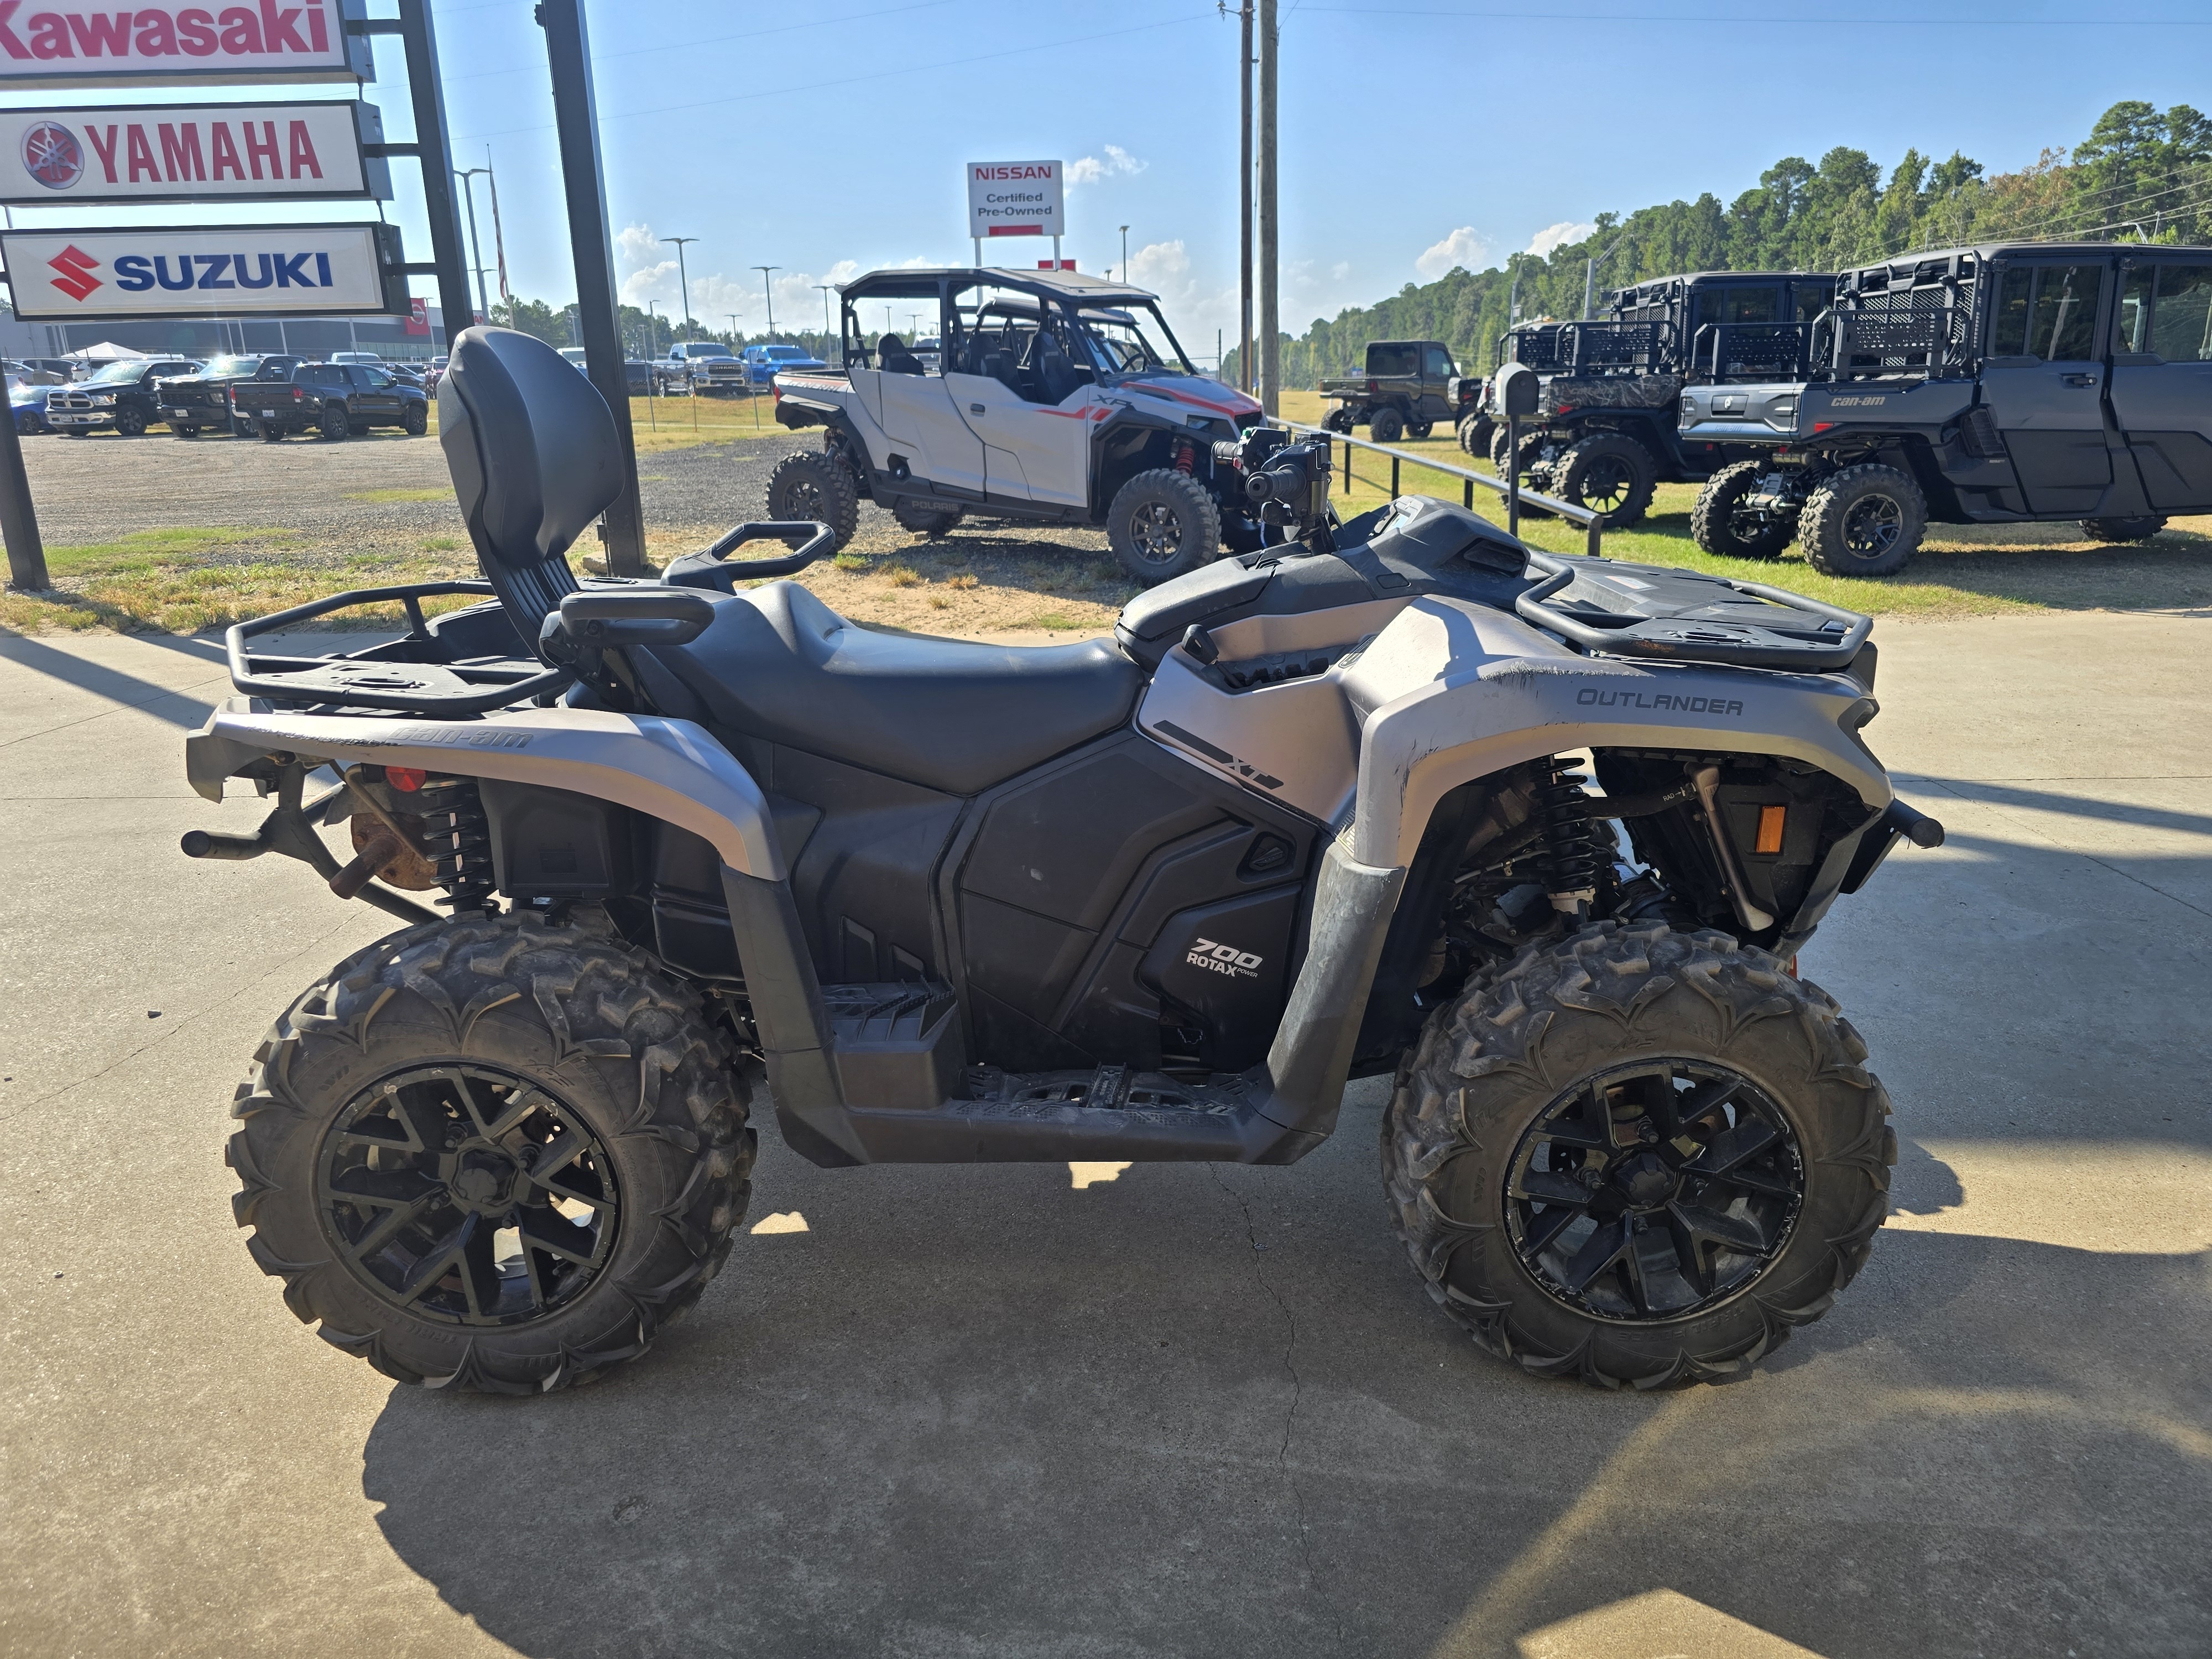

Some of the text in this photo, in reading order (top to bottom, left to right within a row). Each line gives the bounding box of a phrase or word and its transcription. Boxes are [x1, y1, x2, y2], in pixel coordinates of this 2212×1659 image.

[84, 120, 324, 183] YAMAHA
[975, 166, 1051, 180] NISSAN
[987, 193, 1043, 203] Certified
[978, 206, 1052, 216] Pre-Owned
[114, 253, 333, 291] SUZUKI
[787, 381, 840, 394] GENERAL
[1831, 397, 1886, 406] can-am
[912, 501, 959, 512] POLARIS
[1577, 688, 1744, 716] OUTLANDER
[387, 728, 534, 748] can-am
[1223, 756, 1269, 780] XT
[1663, 792, 1675, 802] RAD
[1191, 937, 1263, 969] 700
[1186, 952, 1258, 978] ROTAX POWER
